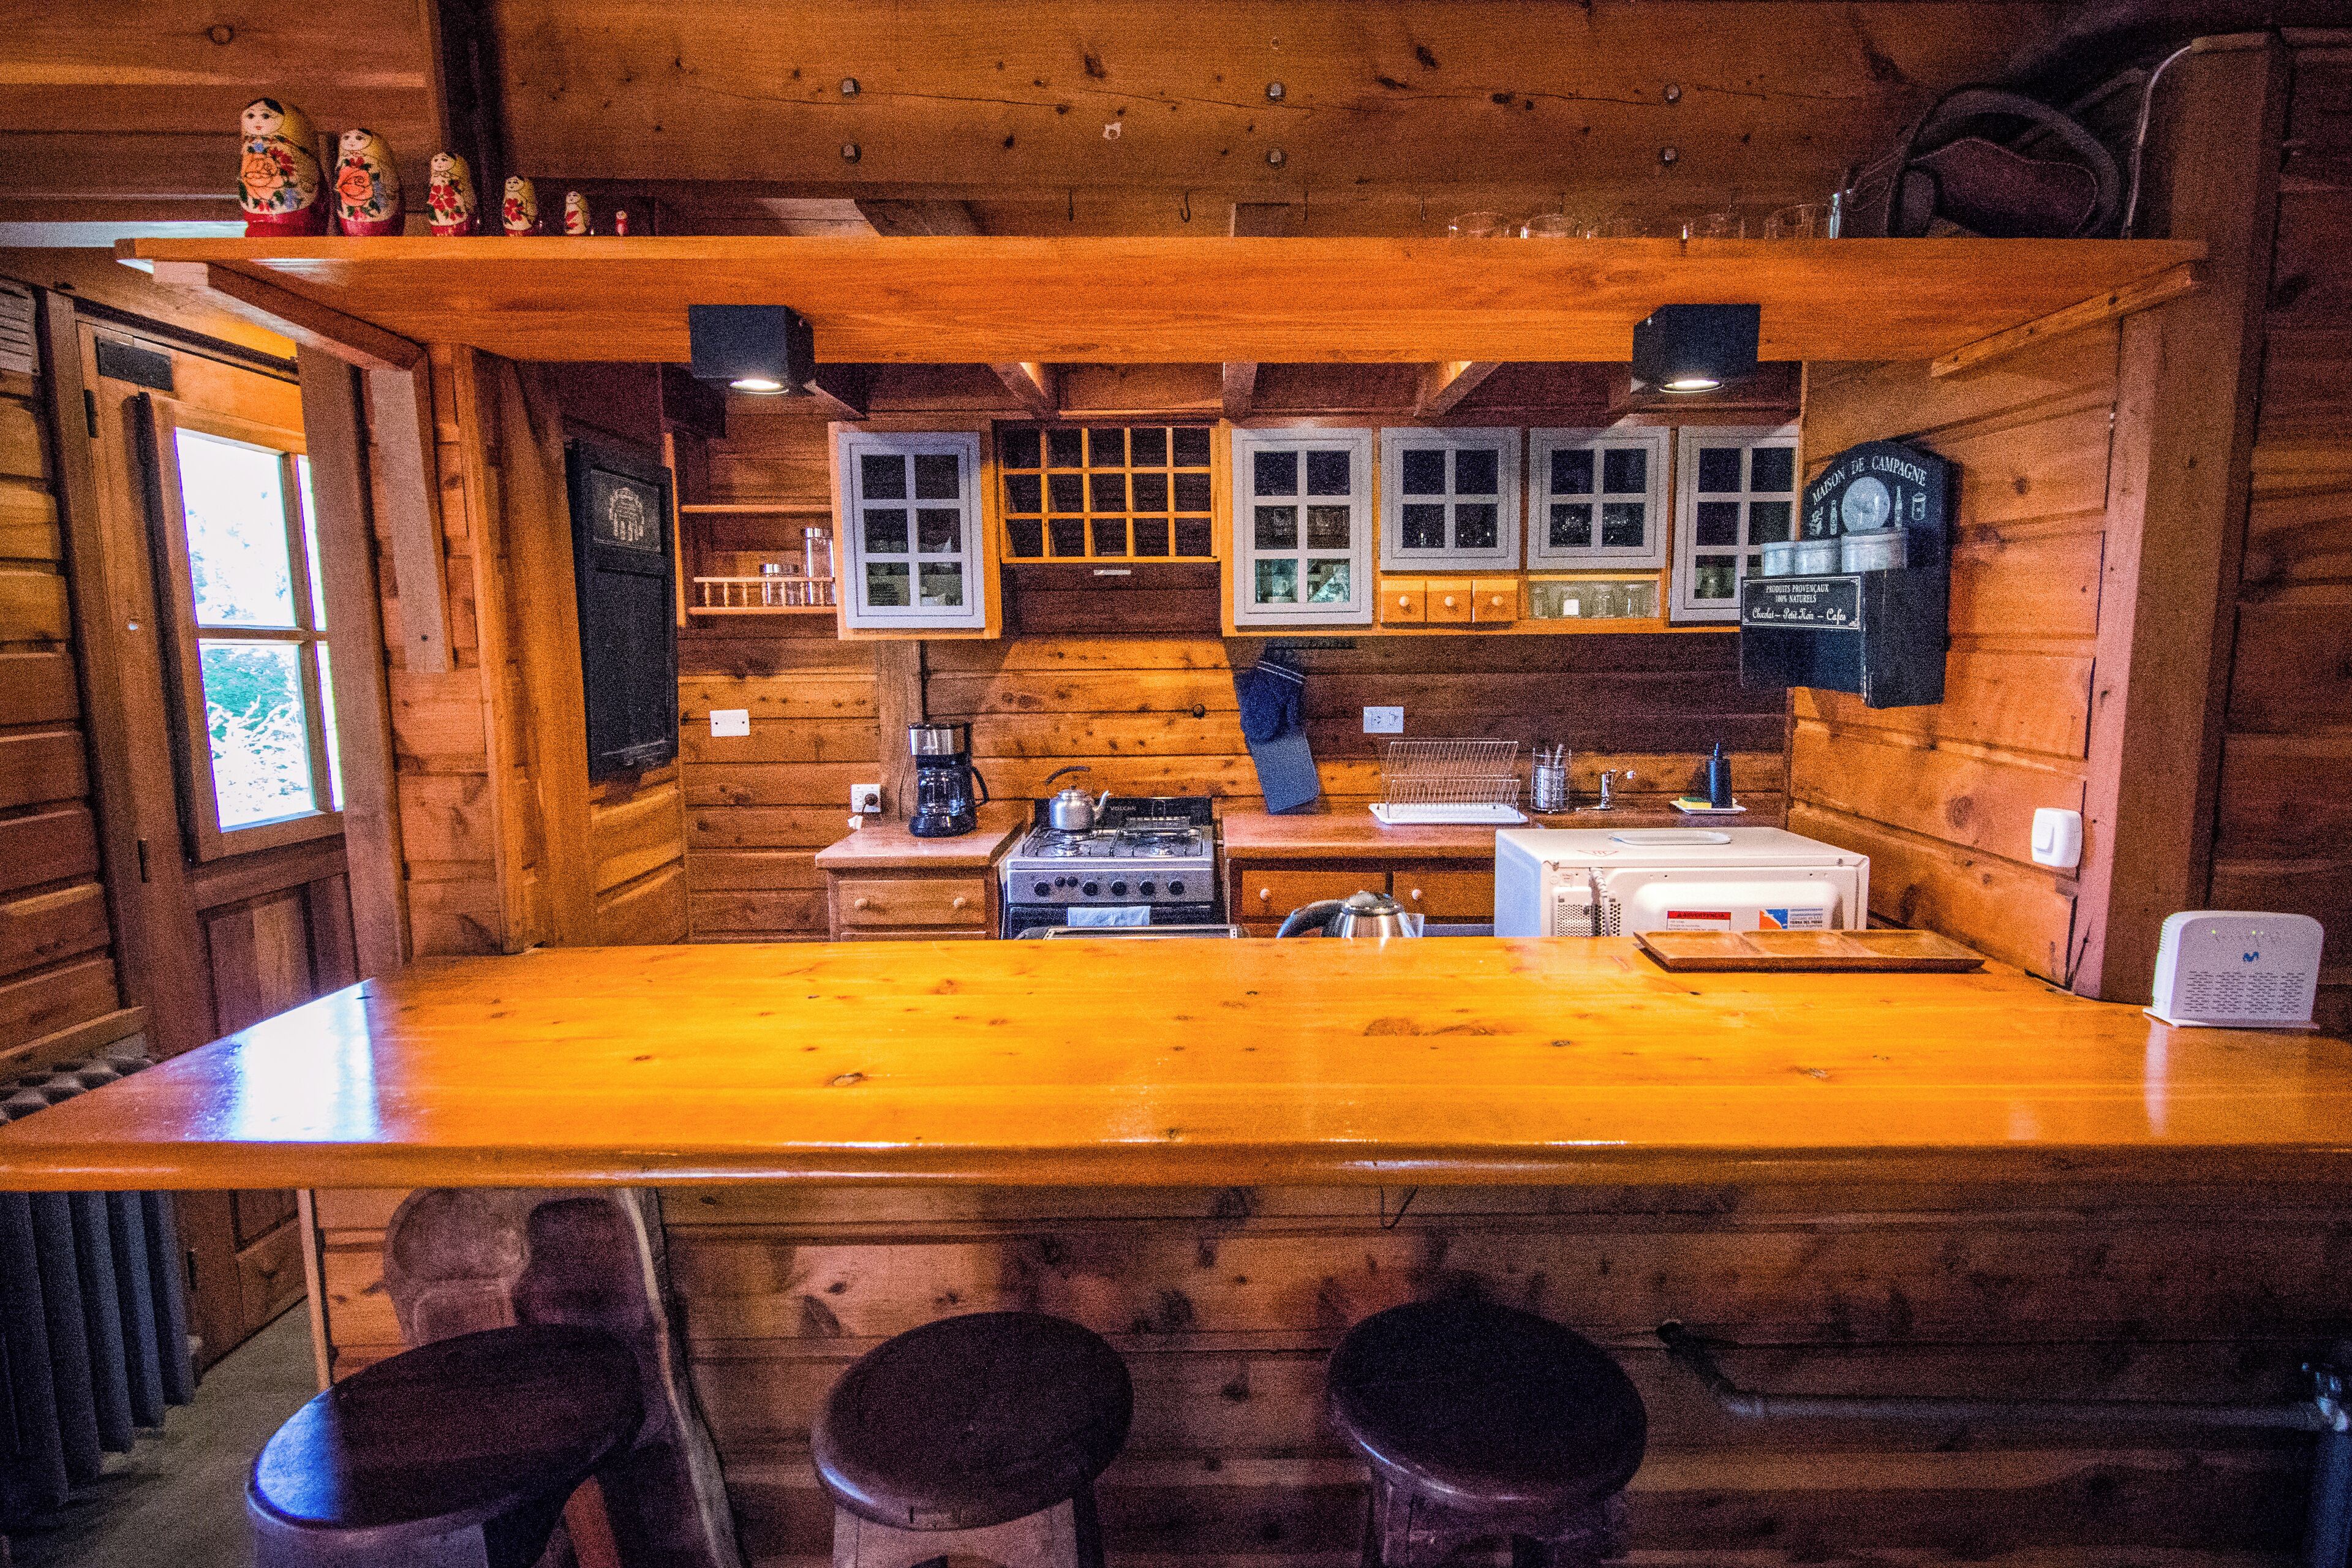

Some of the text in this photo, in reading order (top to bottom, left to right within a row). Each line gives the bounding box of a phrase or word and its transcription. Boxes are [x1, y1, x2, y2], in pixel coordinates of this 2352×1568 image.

[1812, 456, 1927, 505] MAISON DE CAMPAGNE
[1766, 584, 1829, 594] PRODUITS PROVENÇAUX
[1789, 594, 1817, 603] NATURELS
[1752, 607, 1774, 619] Chocolat
[1783, 607, 1798, 619] Petit
[1798, 608, 1814, 620] Noir
